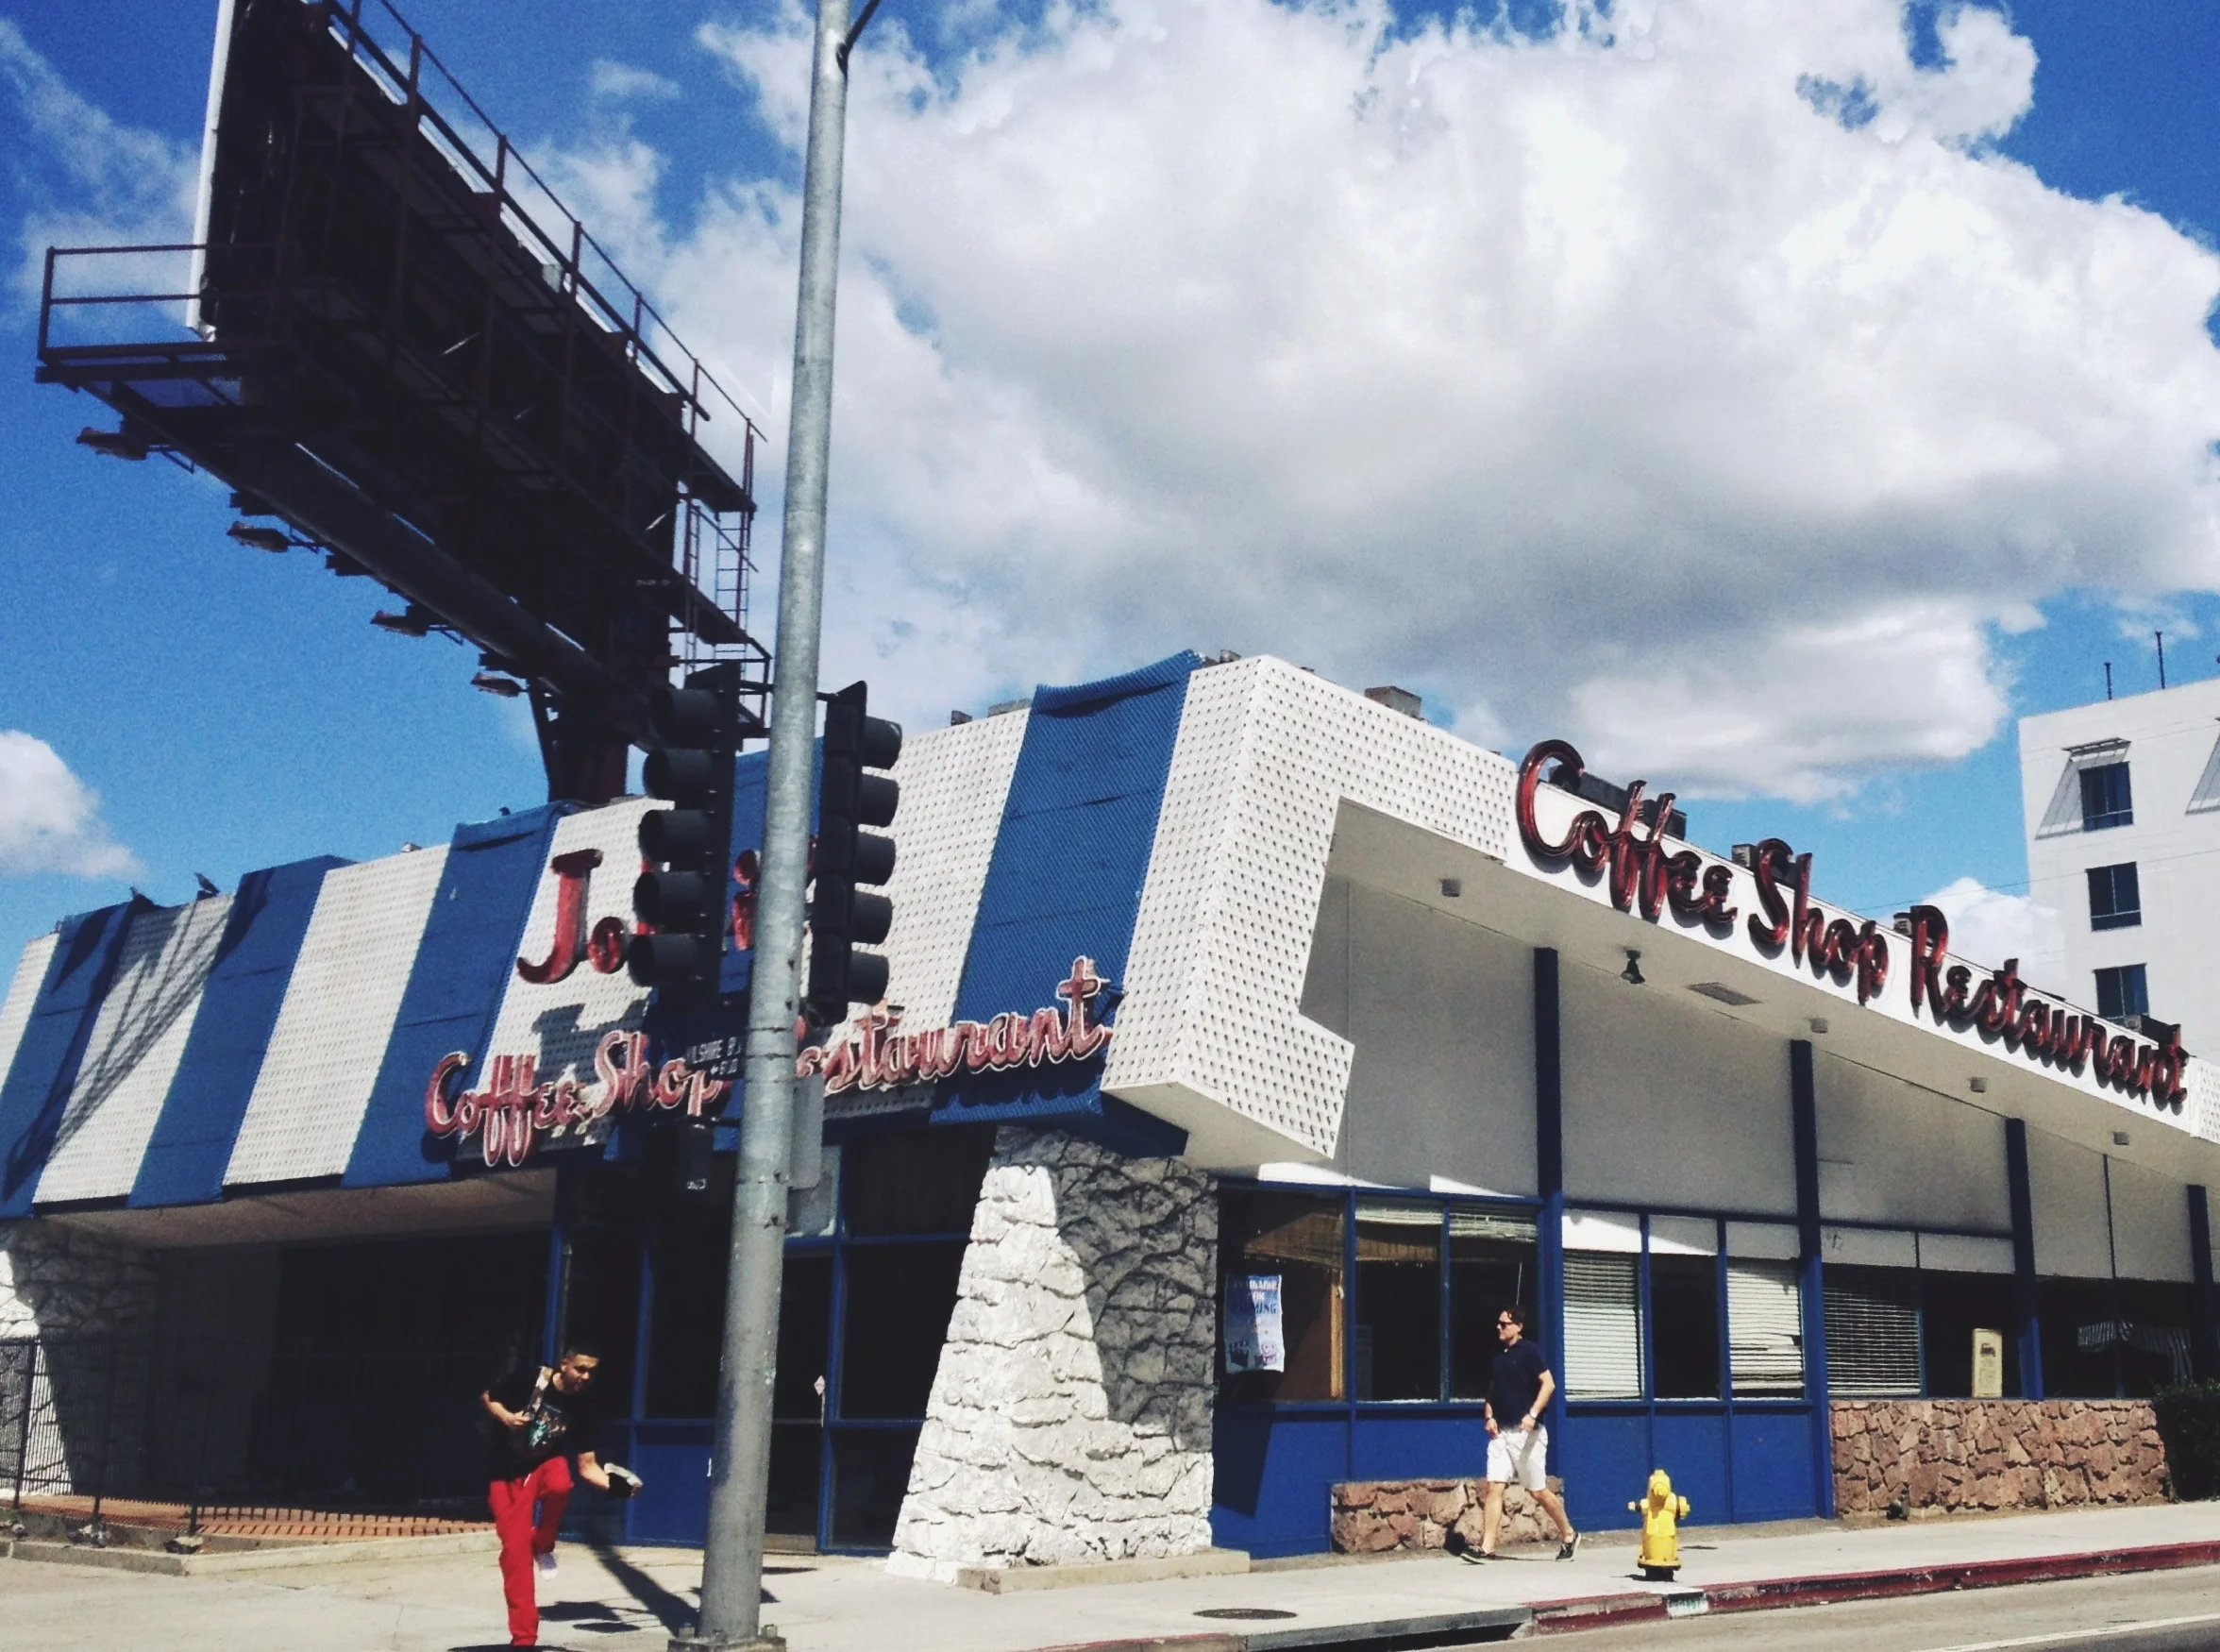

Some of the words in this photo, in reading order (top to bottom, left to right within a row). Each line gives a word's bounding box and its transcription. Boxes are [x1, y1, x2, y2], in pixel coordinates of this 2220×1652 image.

[1516, 739, 1738, 923] Coffee
[1748, 838, 1889, 1005] Shop
[1910, 904, 2188, 1103] Restaurant
[426, 1051, 590, 1167] Coffee
[593, 1029, 730, 1116] Shop
[796, 954, 1113, 1095] estaurant
[1230, 1302, 1276, 1314] MING
